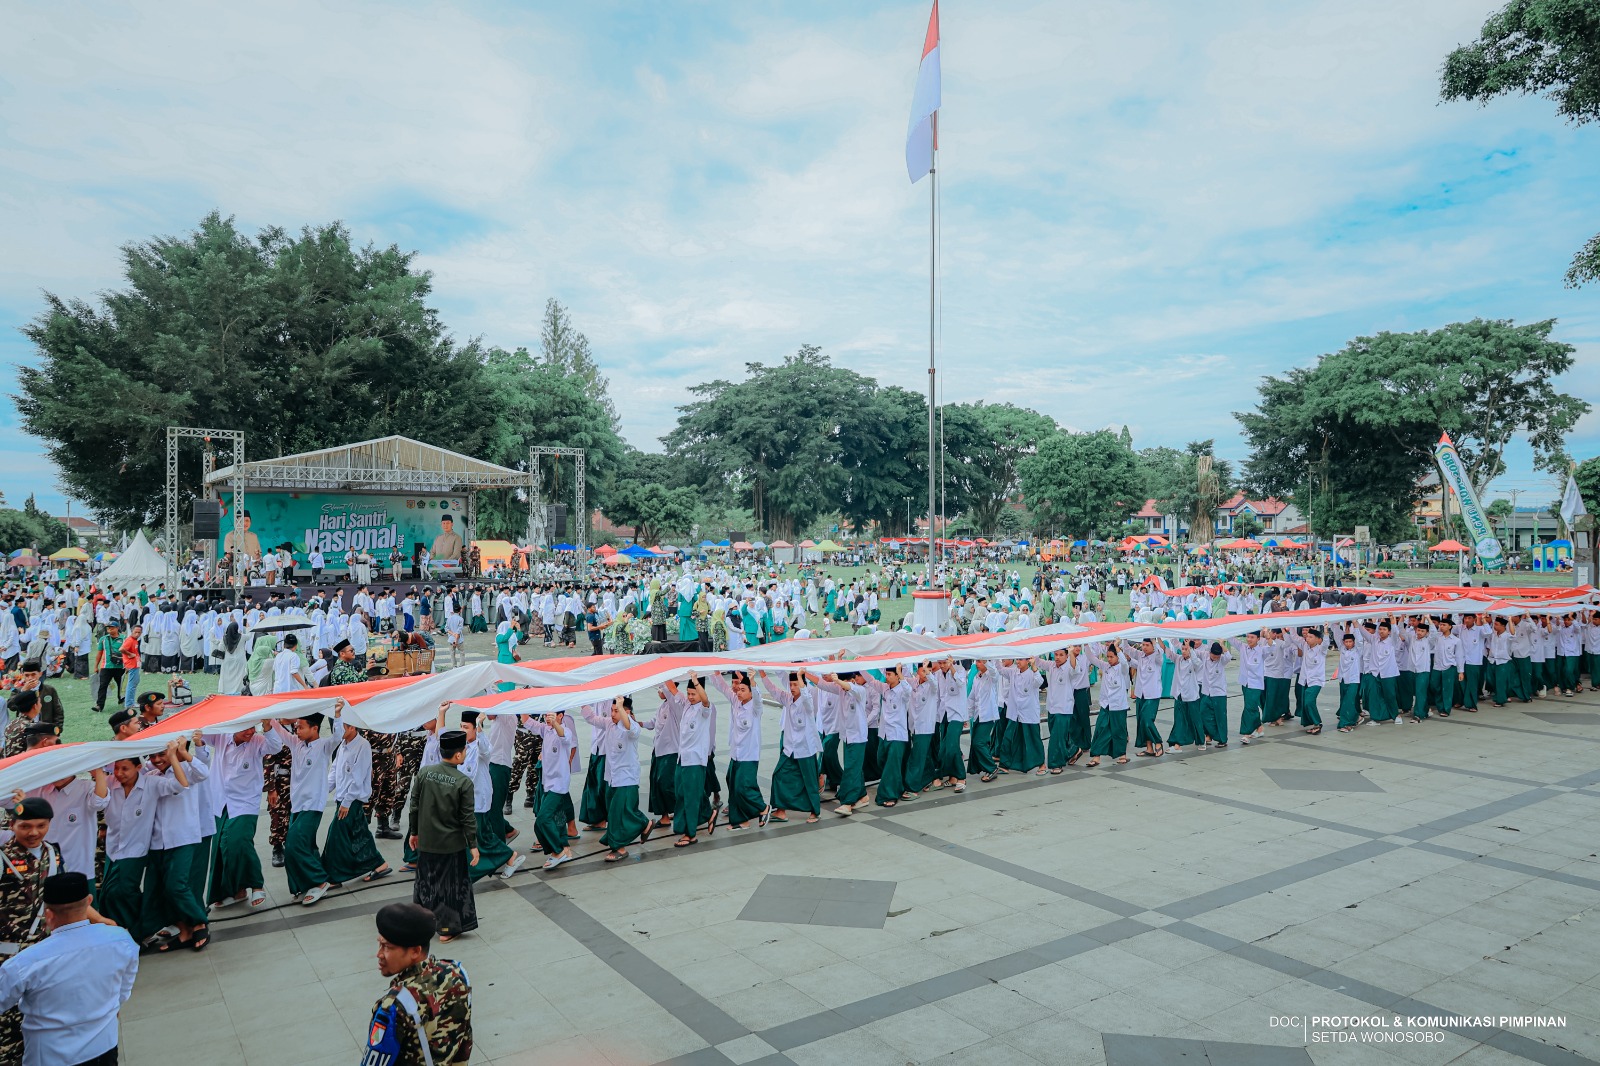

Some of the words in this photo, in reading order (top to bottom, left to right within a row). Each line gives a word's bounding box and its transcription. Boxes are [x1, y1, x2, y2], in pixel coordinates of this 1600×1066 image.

[320, 512, 346, 530] Hari
[348, 509, 387, 528] Santri
[304, 523, 397, 554] Nasional
